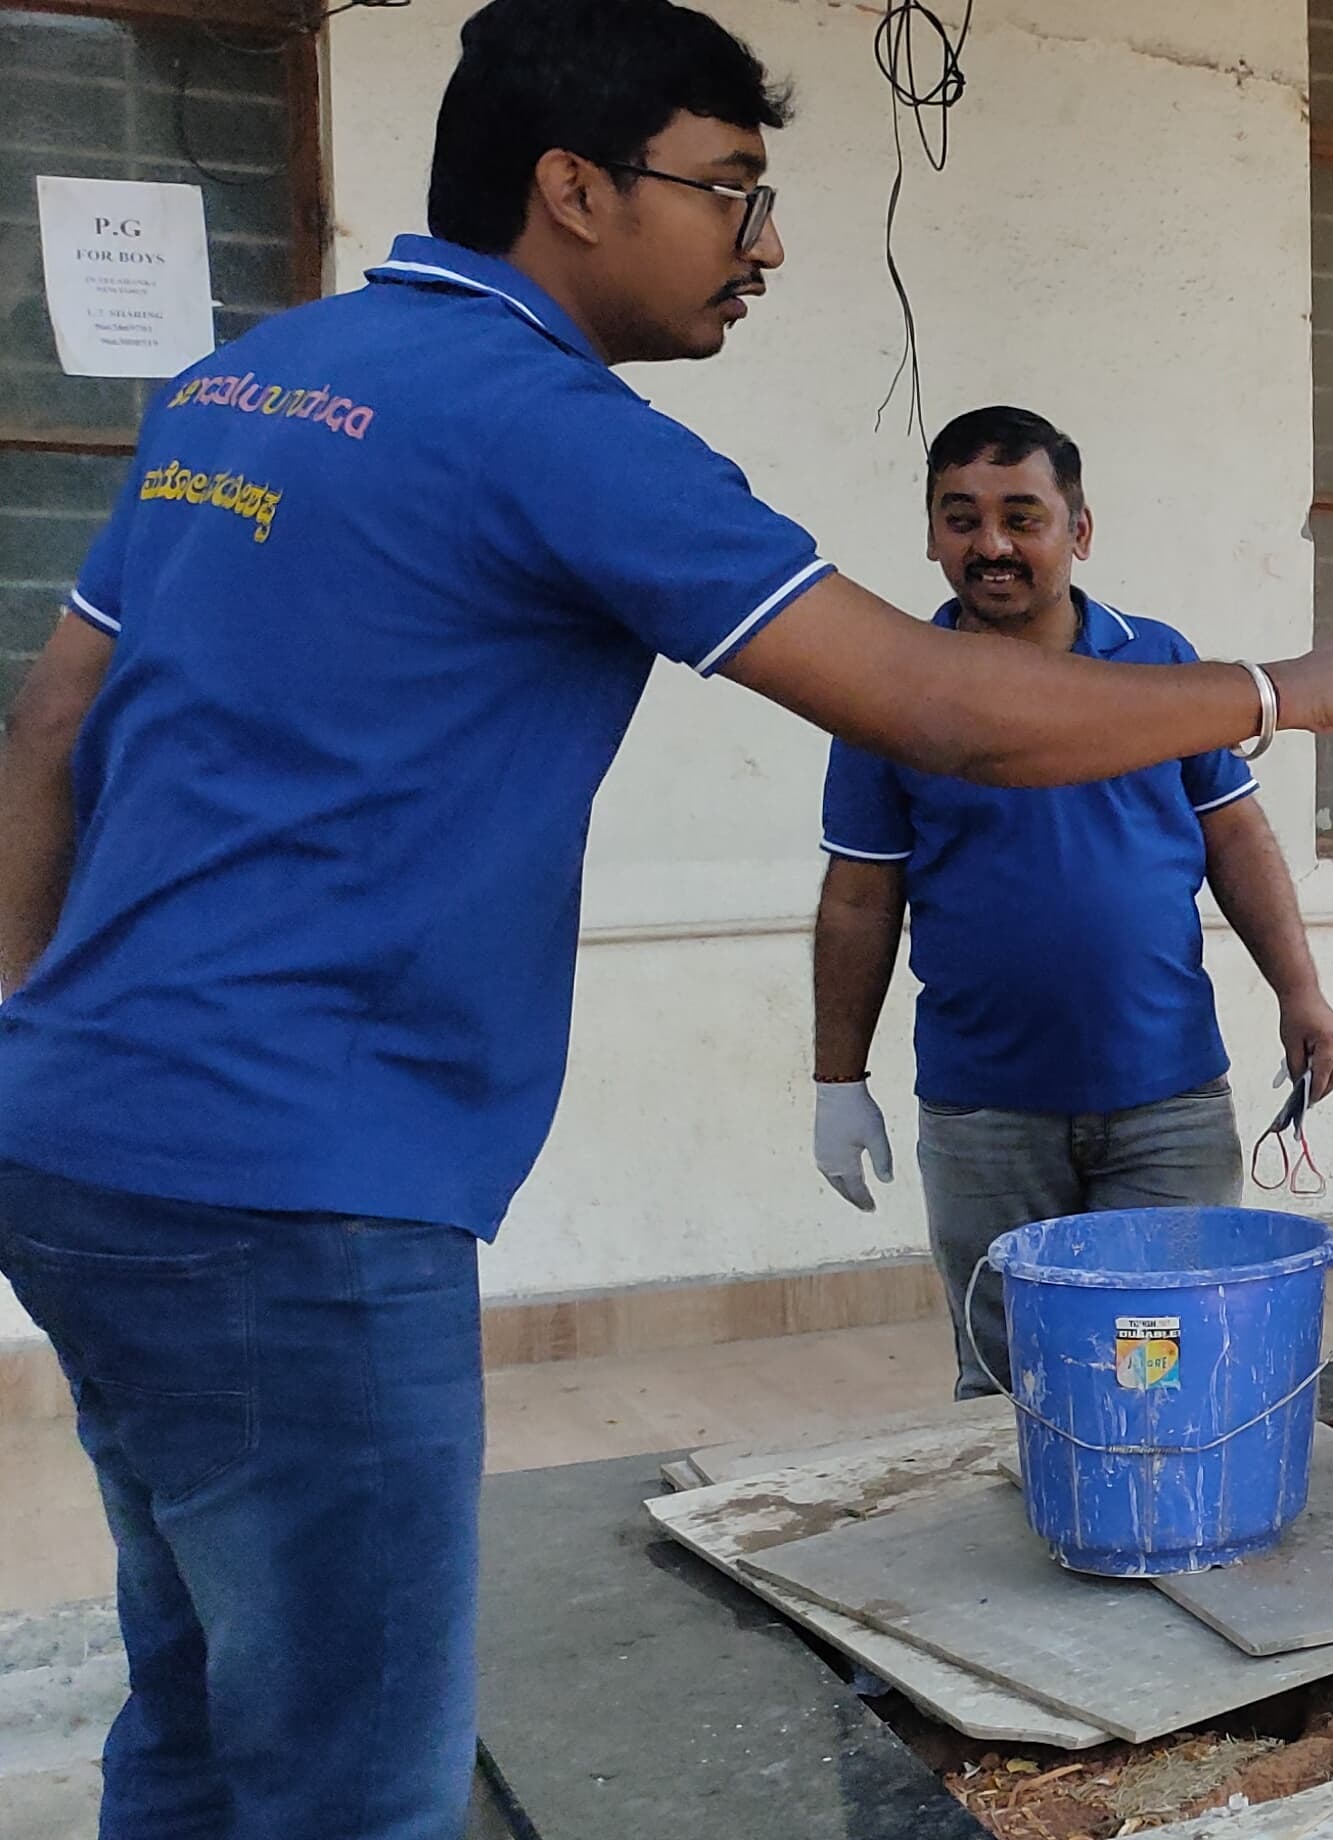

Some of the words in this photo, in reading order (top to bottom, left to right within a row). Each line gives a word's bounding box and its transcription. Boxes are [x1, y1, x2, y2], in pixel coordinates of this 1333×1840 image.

[95, 217, 142, 237] P.G
[76, 249, 113, 261] FOR
[119, 251, 165, 264] BOYS
[1119, 1330, 1179, 1338] DUABLE
